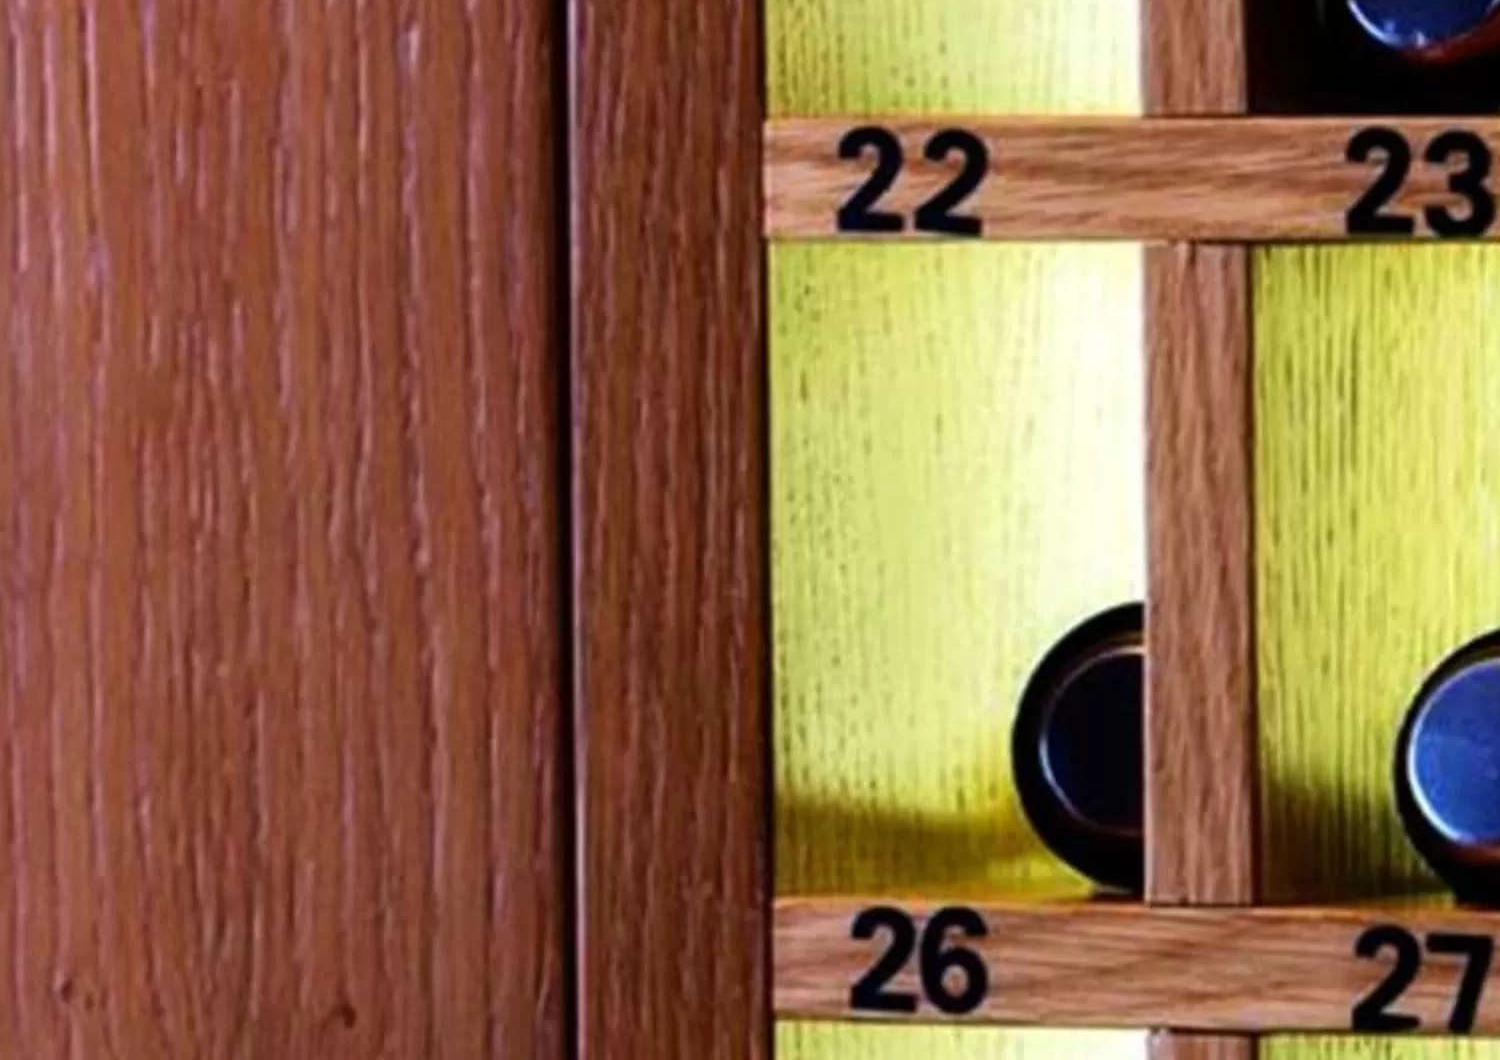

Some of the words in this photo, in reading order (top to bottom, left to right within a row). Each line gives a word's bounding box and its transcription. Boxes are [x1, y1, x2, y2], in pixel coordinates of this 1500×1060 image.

[837, 125, 990, 238] 22
[1344, 126, 1498, 240] 23
[849, 906, 989, 1015] 26
[1350, 924, 1496, 1035] 27
